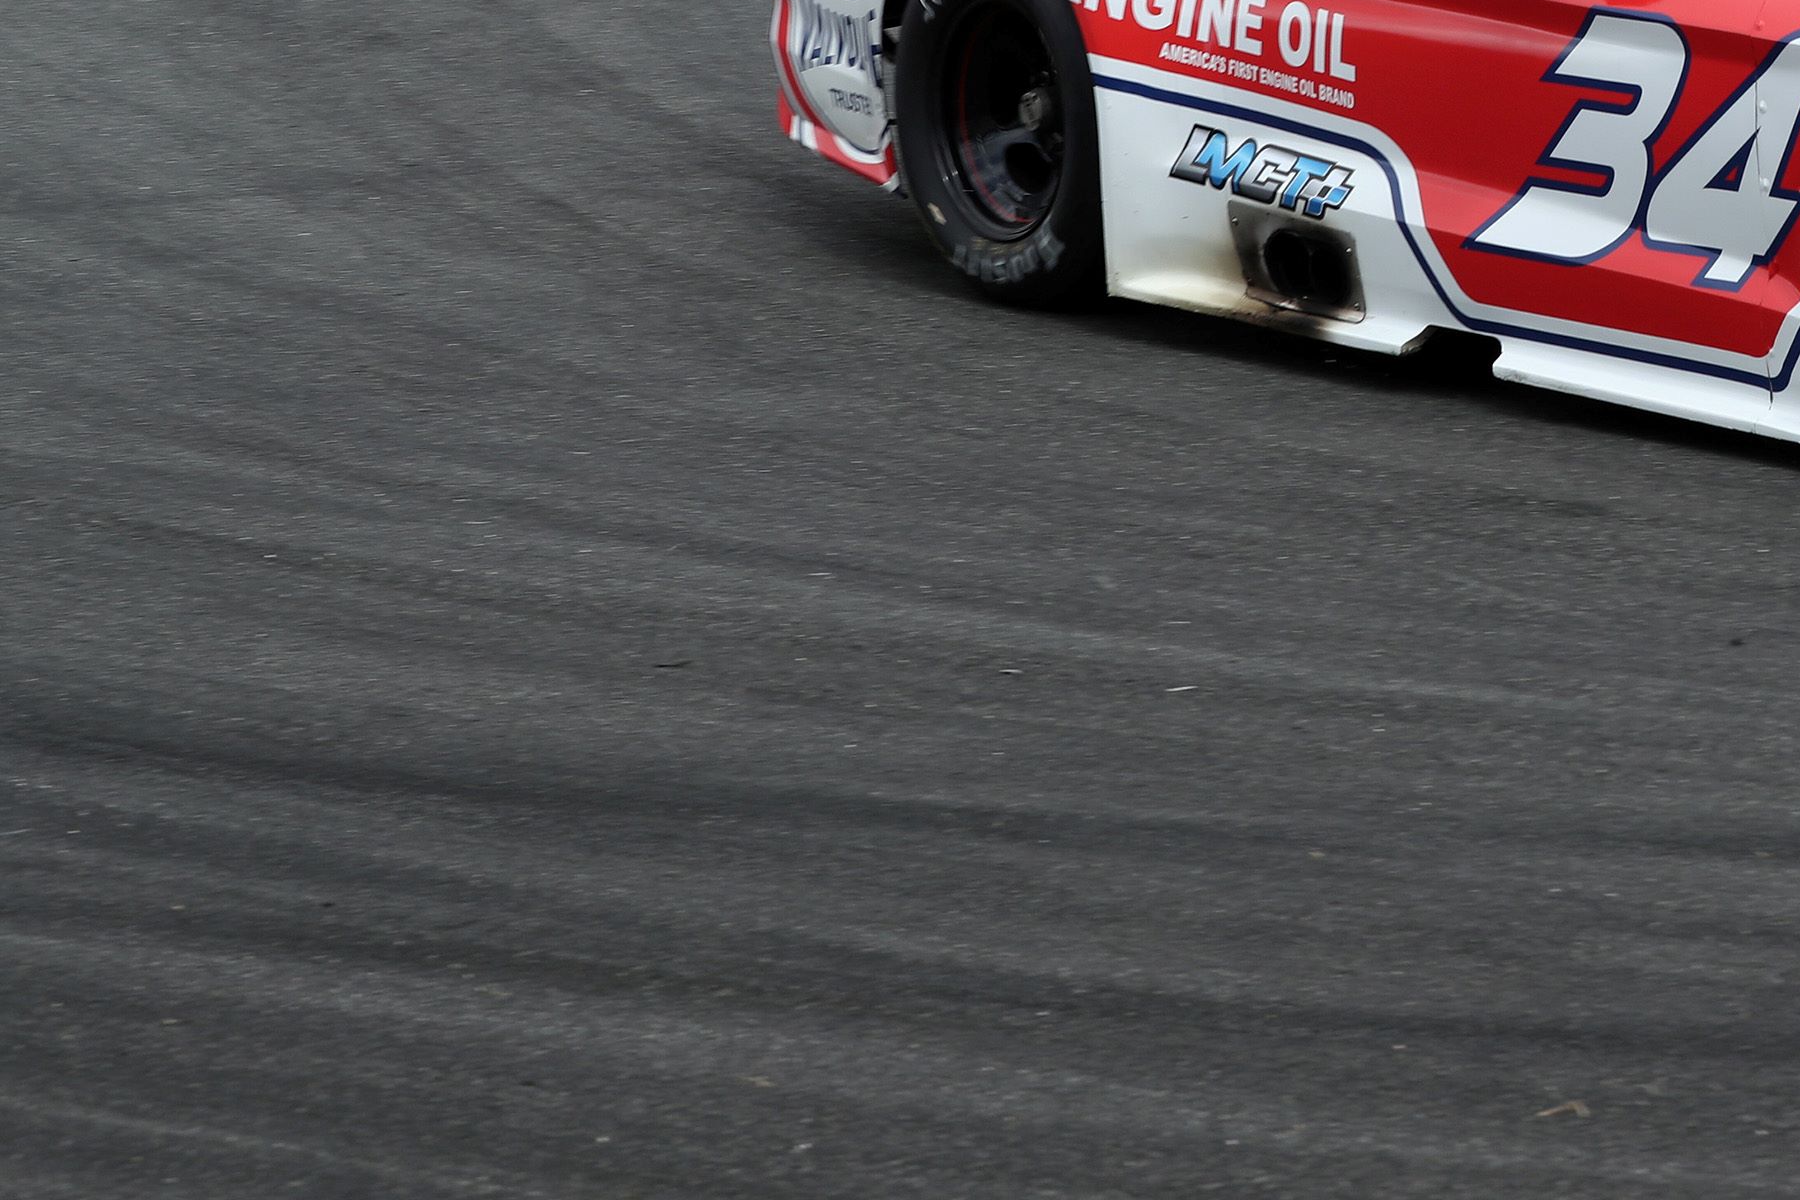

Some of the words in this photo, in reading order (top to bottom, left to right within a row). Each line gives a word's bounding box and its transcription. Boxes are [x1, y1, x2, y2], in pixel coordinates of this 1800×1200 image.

[1158, 42, 1227, 74] AMERICA'S
[1227, 60, 1260, 81] FIRST
[1259, 67, 1299, 93] ENGINE
[1299, 76, 1318, 98] OIL
[1318, 83, 1355, 109] BRAND
[1277, 0, 1357, 83] OIL
